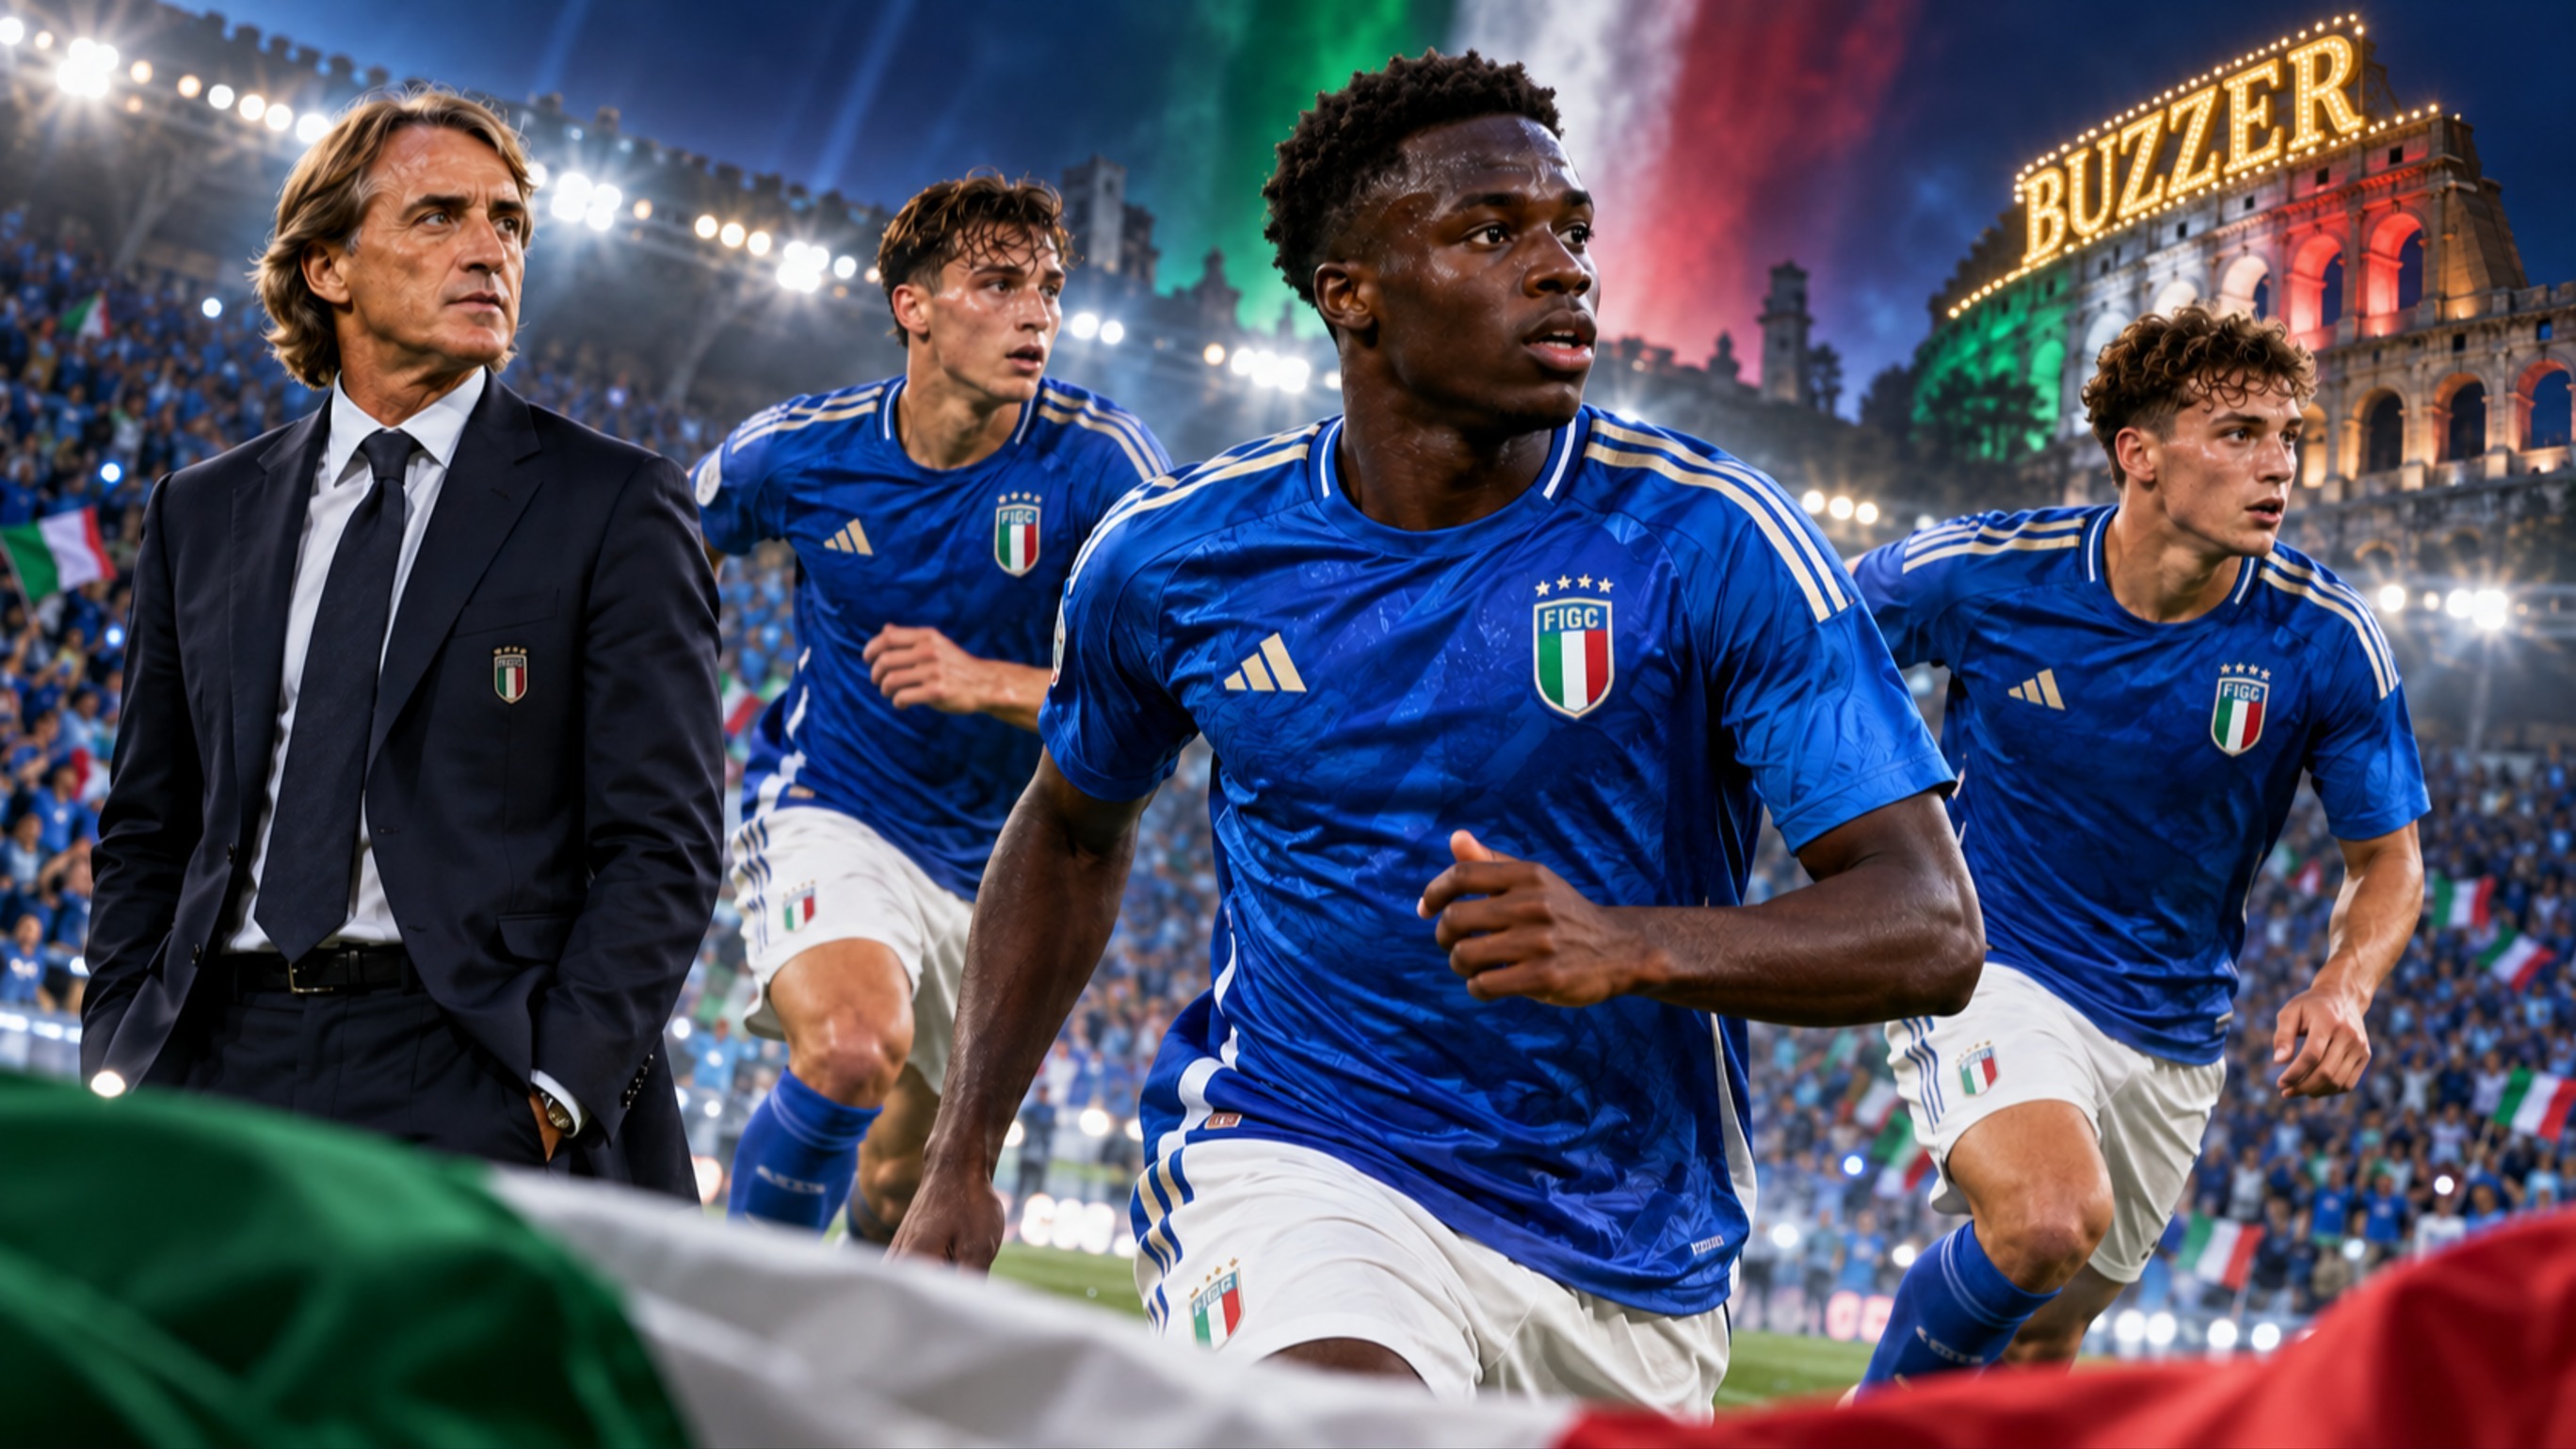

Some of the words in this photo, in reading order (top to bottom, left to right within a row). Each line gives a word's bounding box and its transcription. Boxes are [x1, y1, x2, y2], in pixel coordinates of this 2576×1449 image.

[2021, 34, 2365, 266] BUZZER
[1544, 607, 1599, 632] FIGC
[2223, 683, 2260, 700] FIGC
